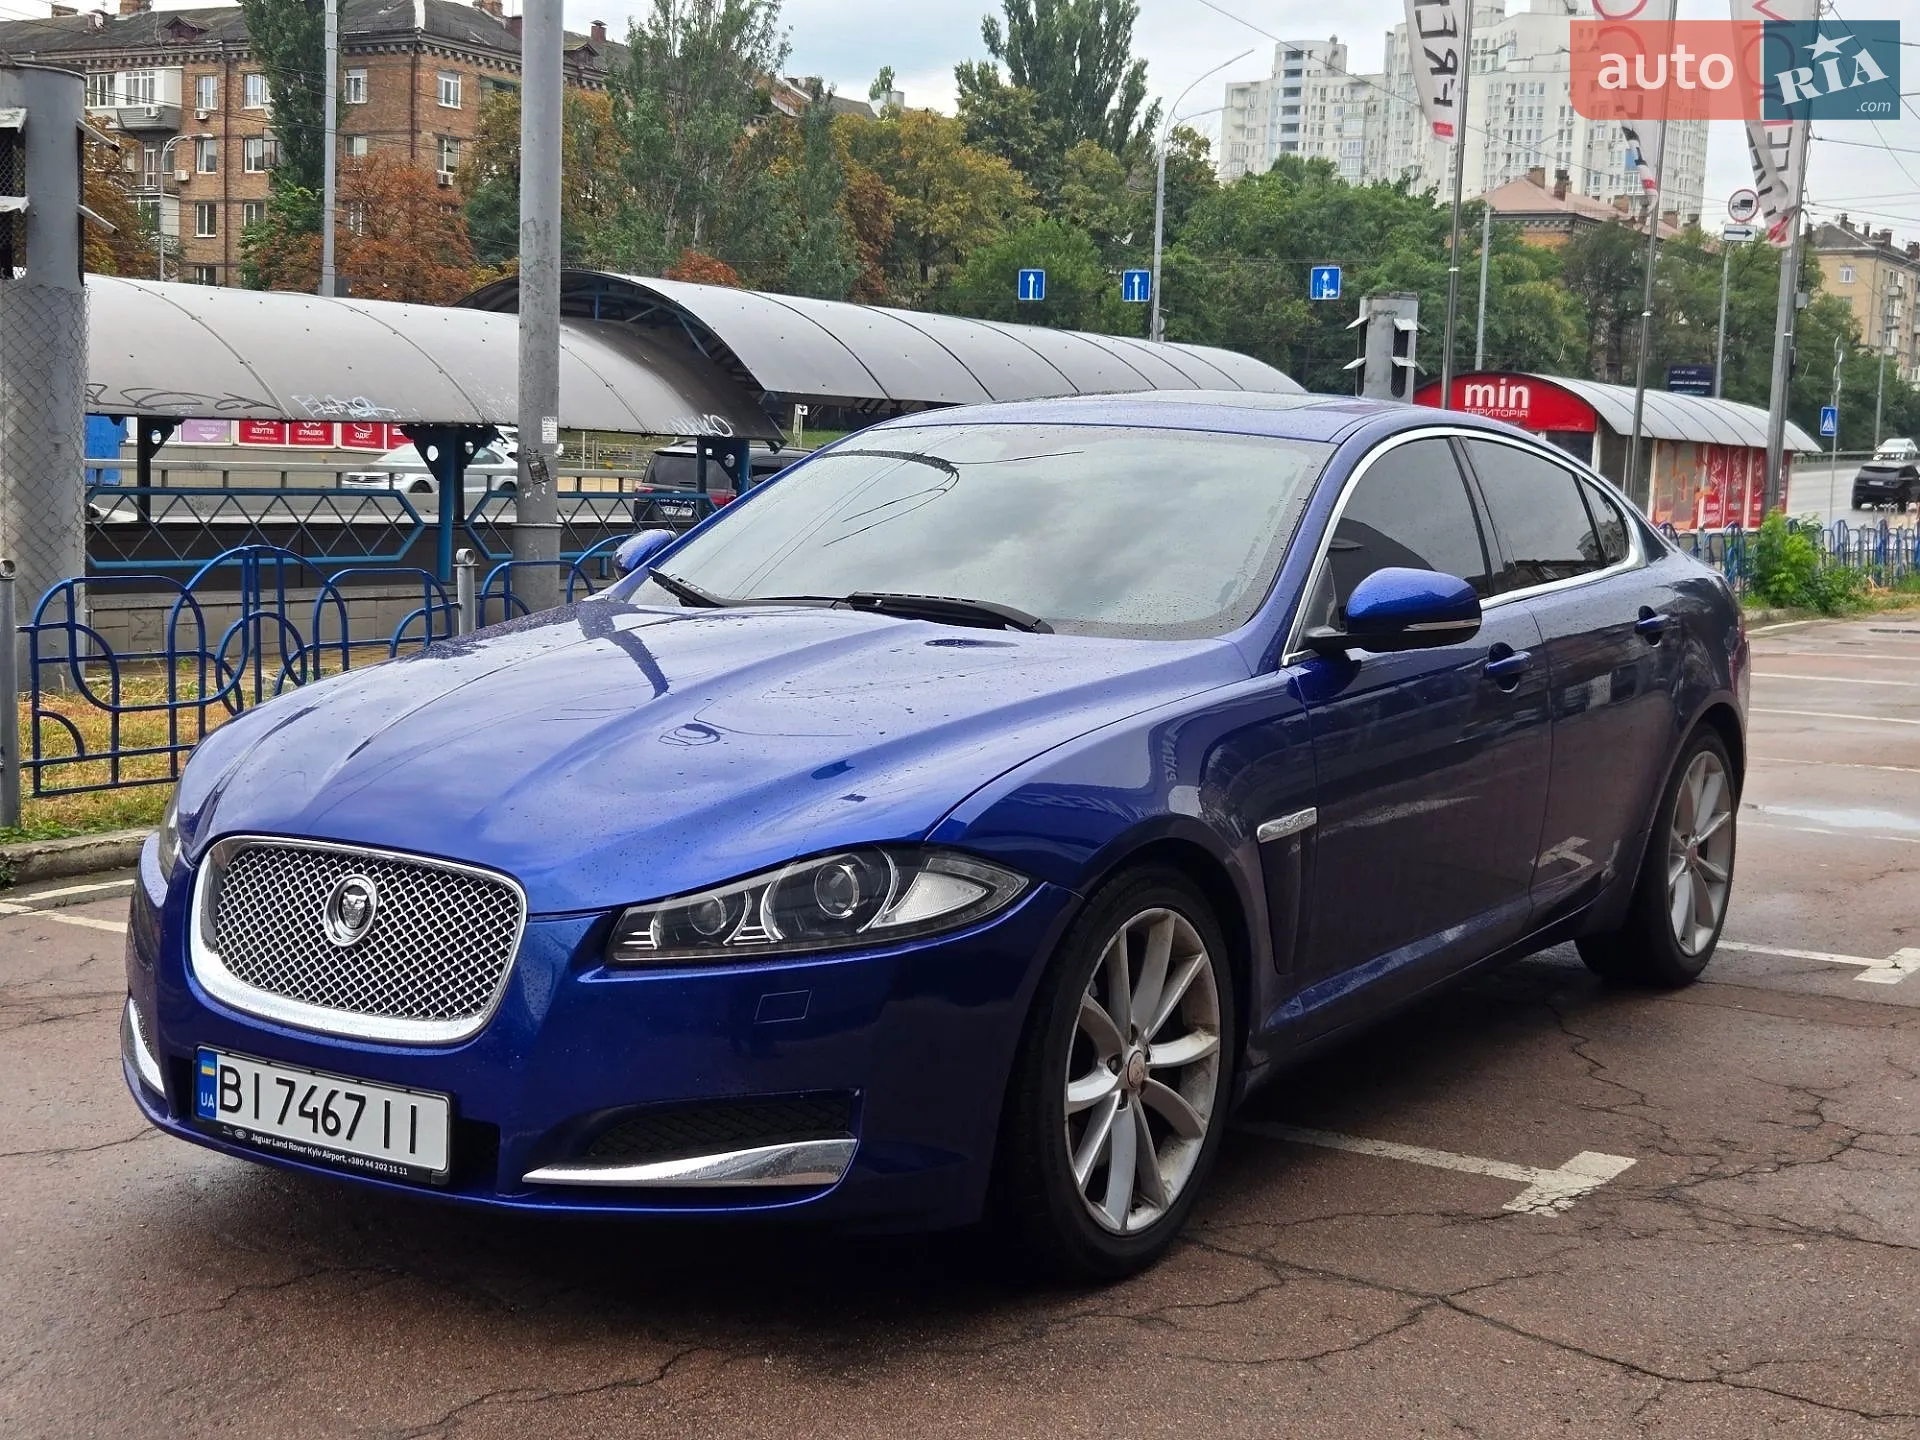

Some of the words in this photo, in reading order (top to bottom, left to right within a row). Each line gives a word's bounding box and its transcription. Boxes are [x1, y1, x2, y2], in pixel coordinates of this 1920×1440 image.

[1464, 377, 1529, 409] min
[200, 1092, 215, 1109] UA
[219, 1064, 260, 1120] BI
[276, 1077, 367, 1141] 7467
[251, 1133, 272, 1145] Jaguar
[272, 1138, 288, 1149] Land
[288, 1142, 307, 1153] Rover
[307, 1146, 321, 1158] Kyiv
[347, 1157, 364, 1167] +380
[365, 1160, 374, 1169] 44
[374, 1161, 388, 1172] 202
[389, 1165, 398, 1174] 11
[399, 1167, 408, 1175] 11
